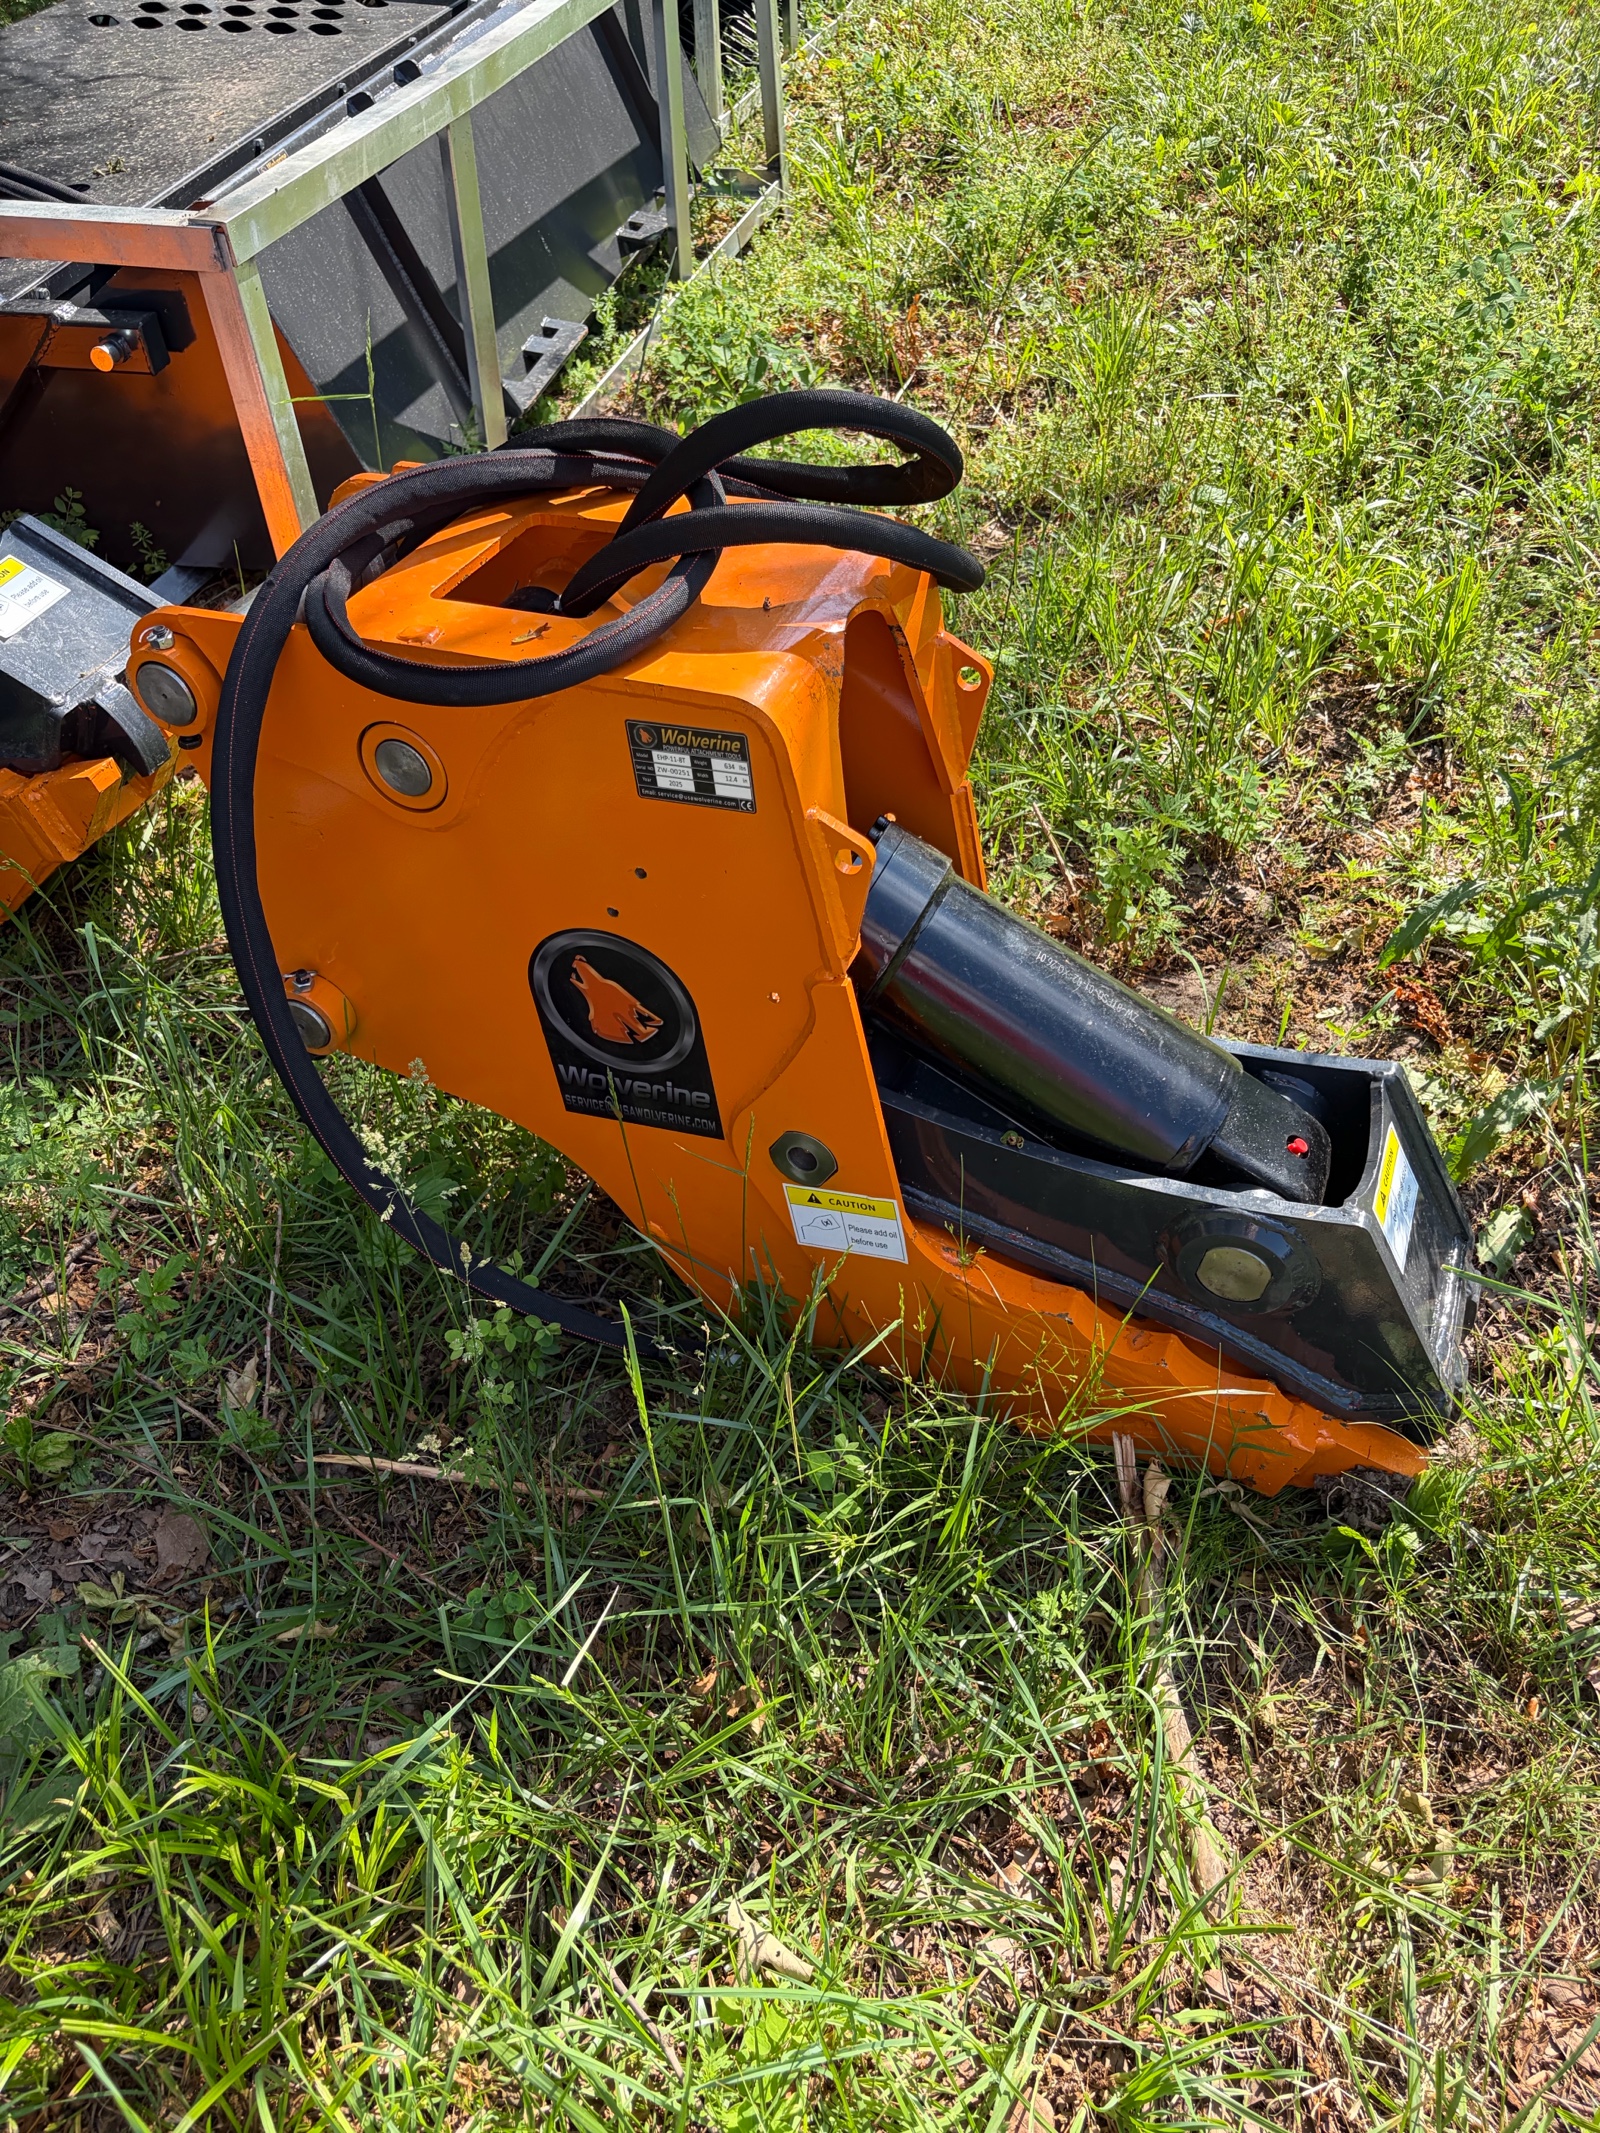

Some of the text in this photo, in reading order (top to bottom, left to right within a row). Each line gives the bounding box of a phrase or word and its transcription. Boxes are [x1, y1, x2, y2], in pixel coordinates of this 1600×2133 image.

[661, 728, 741, 753] Wolverine
[662, 744, 741, 760] POWERFUL ATTACHMENT TOOLS
[657, 754, 686, 764] EHP-11-8T
[657, 766, 690, 777] ZW-00251
[669, 779, 683, 788] 2025
[725, 775, 738, 783] 12.4
[557, 1063, 711, 1109] Woverine
[828, 1198, 876, 1212] CAUTION
[847, 1223, 898, 1239] Please add oil
[850, 1236, 889, 1249] before use
